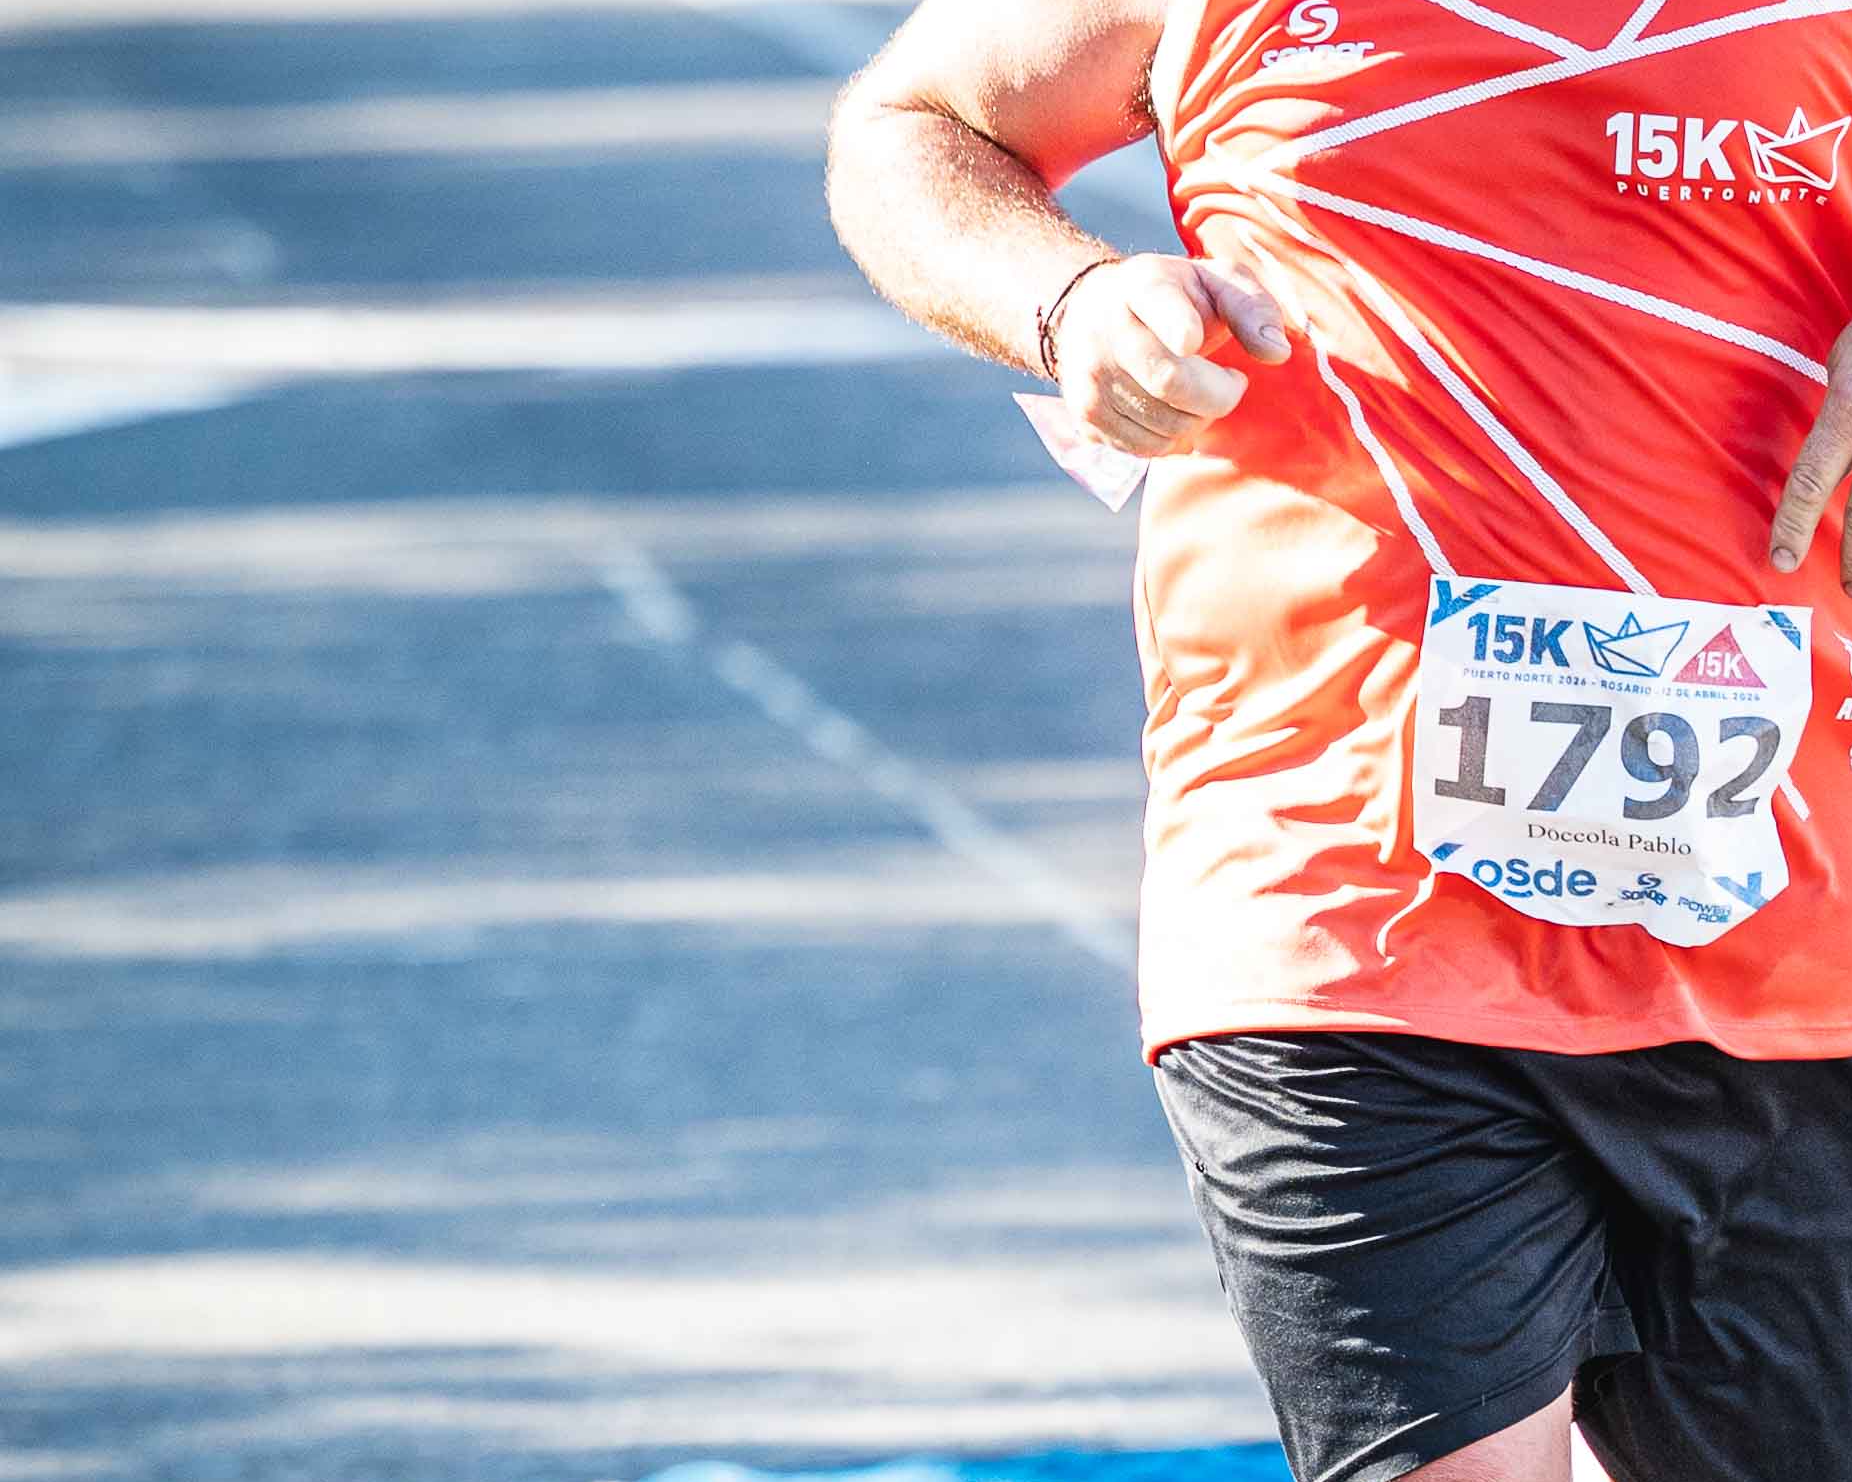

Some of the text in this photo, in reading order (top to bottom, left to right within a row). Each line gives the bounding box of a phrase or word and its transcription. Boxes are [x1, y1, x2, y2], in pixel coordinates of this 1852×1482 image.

[1605, 111, 1738, 181] 15K
[1616, 181, 1735, 202] PUERTO
[1467, 612, 1574, 668] 15K
[1464, 668, 1510, 681] PUERTO
[1514, 673, 1553, 684] NORTE
[1559, 675, 1587, 686] 2026
[1600, 680, 1651, 695] ROSARIO
[1696, 650, 1745, 679] 15K
[1434, 695, 1782, 821] 1792
[1527, 823, 1693, 856] Doccola Pablo
[1472, 858, 1598, 898] osde
